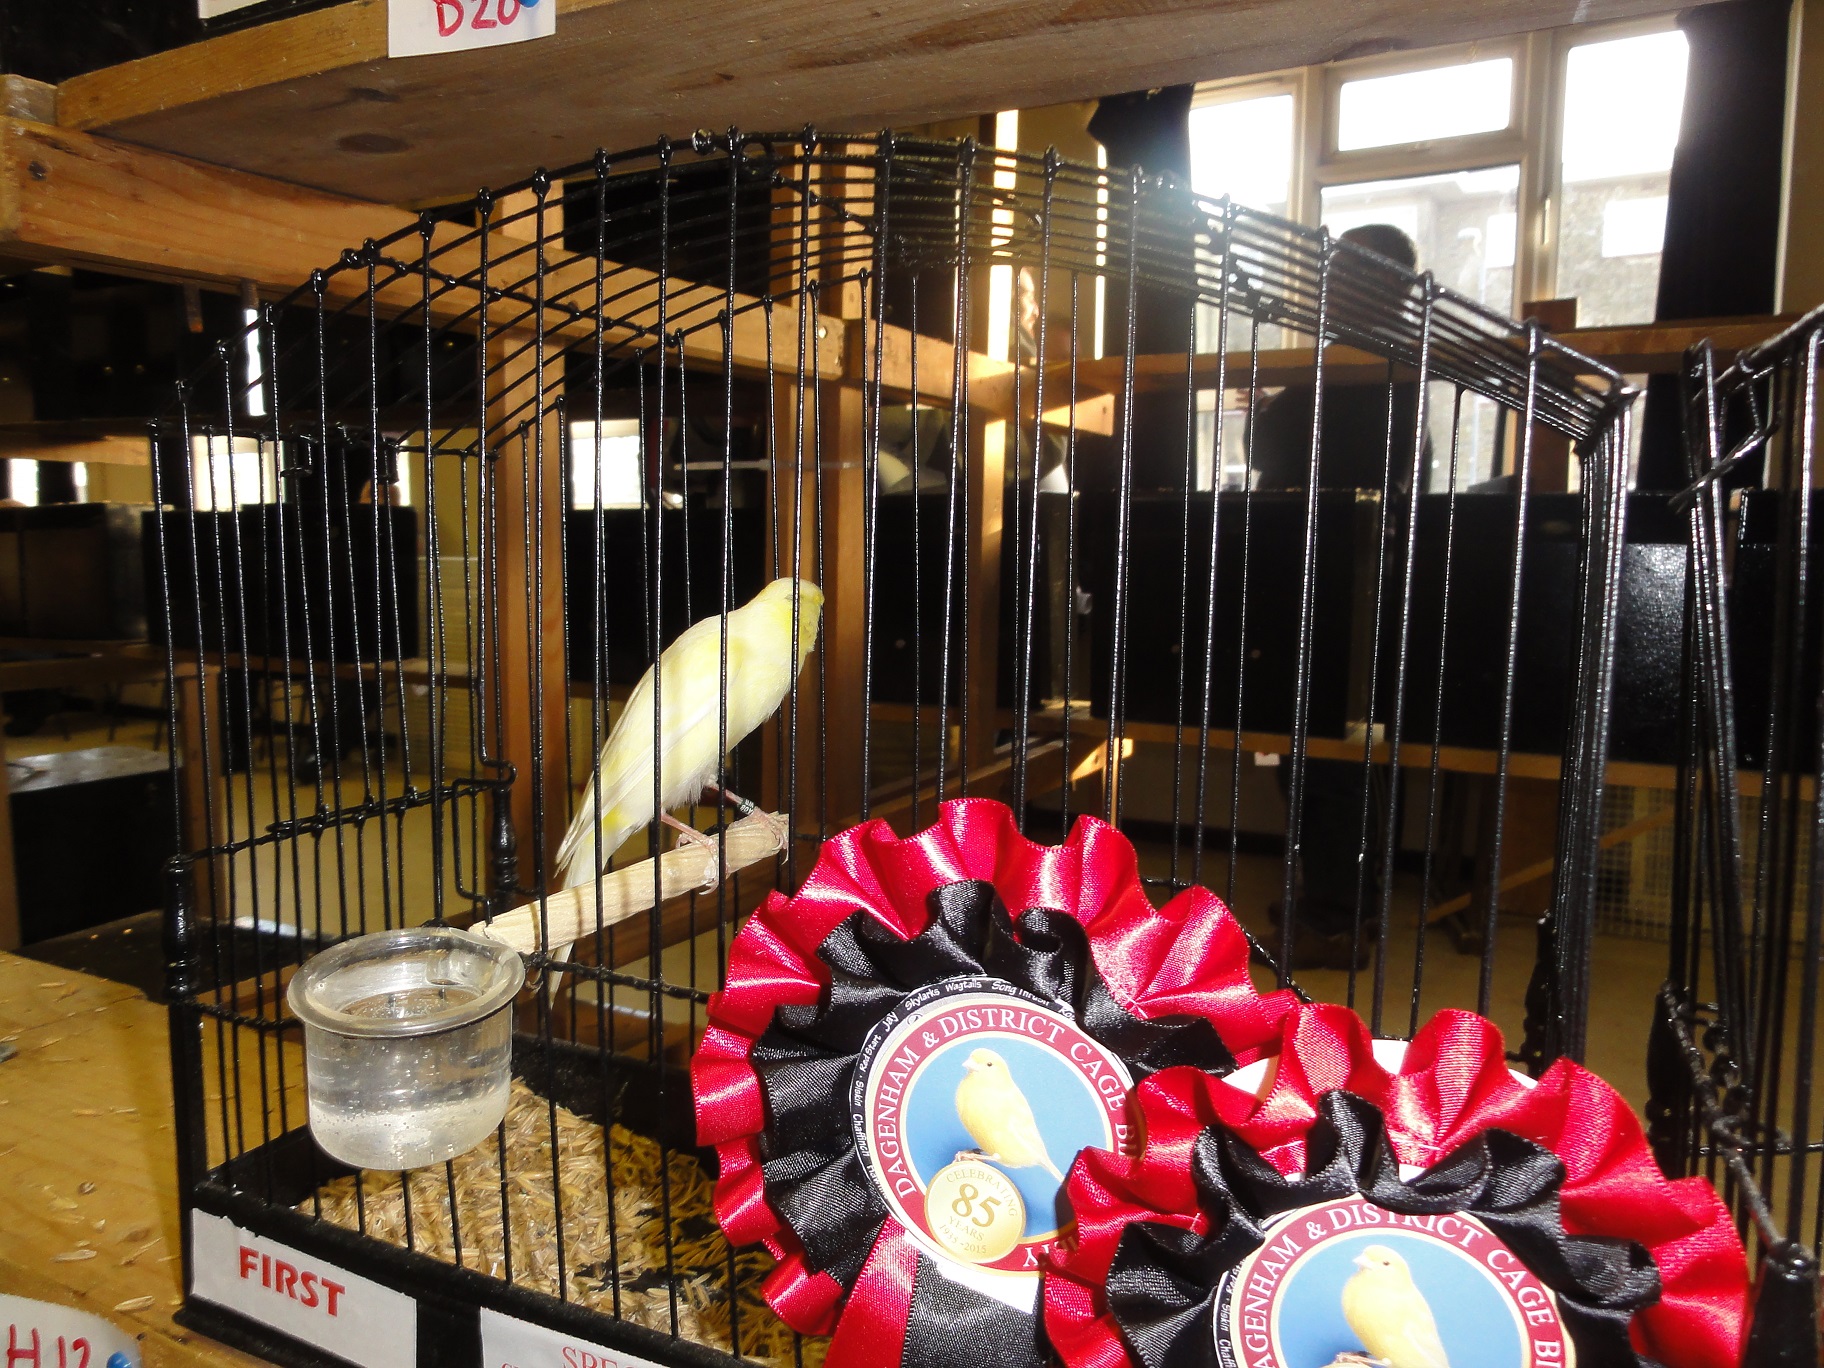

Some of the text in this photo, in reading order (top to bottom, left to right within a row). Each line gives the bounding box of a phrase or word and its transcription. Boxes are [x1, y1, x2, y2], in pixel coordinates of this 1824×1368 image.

[905, 980, 982, 1011] Skylarks Wagtails
[991, 981, 1017, 996] Song
[882, 1011, 899, 1032] Jay
[877, 1008, 1137, 1198] DAGENHAM & DISTRICT CAGE BI
[852, 1113, 870, 1157] Chaffinch
[946, 1169, 1018, 1217] CELEBRATING
[951, 1183, 1002, 1227] 85
[949, 1216, 985, 1241] YEARS
[239, 1245, 346, 1317] FIRST
[1305, 1221, 1328, 1240] &
[1486, 1249, 1555, 1327] CAGE
[562, 1346, 635, 1368] SP
